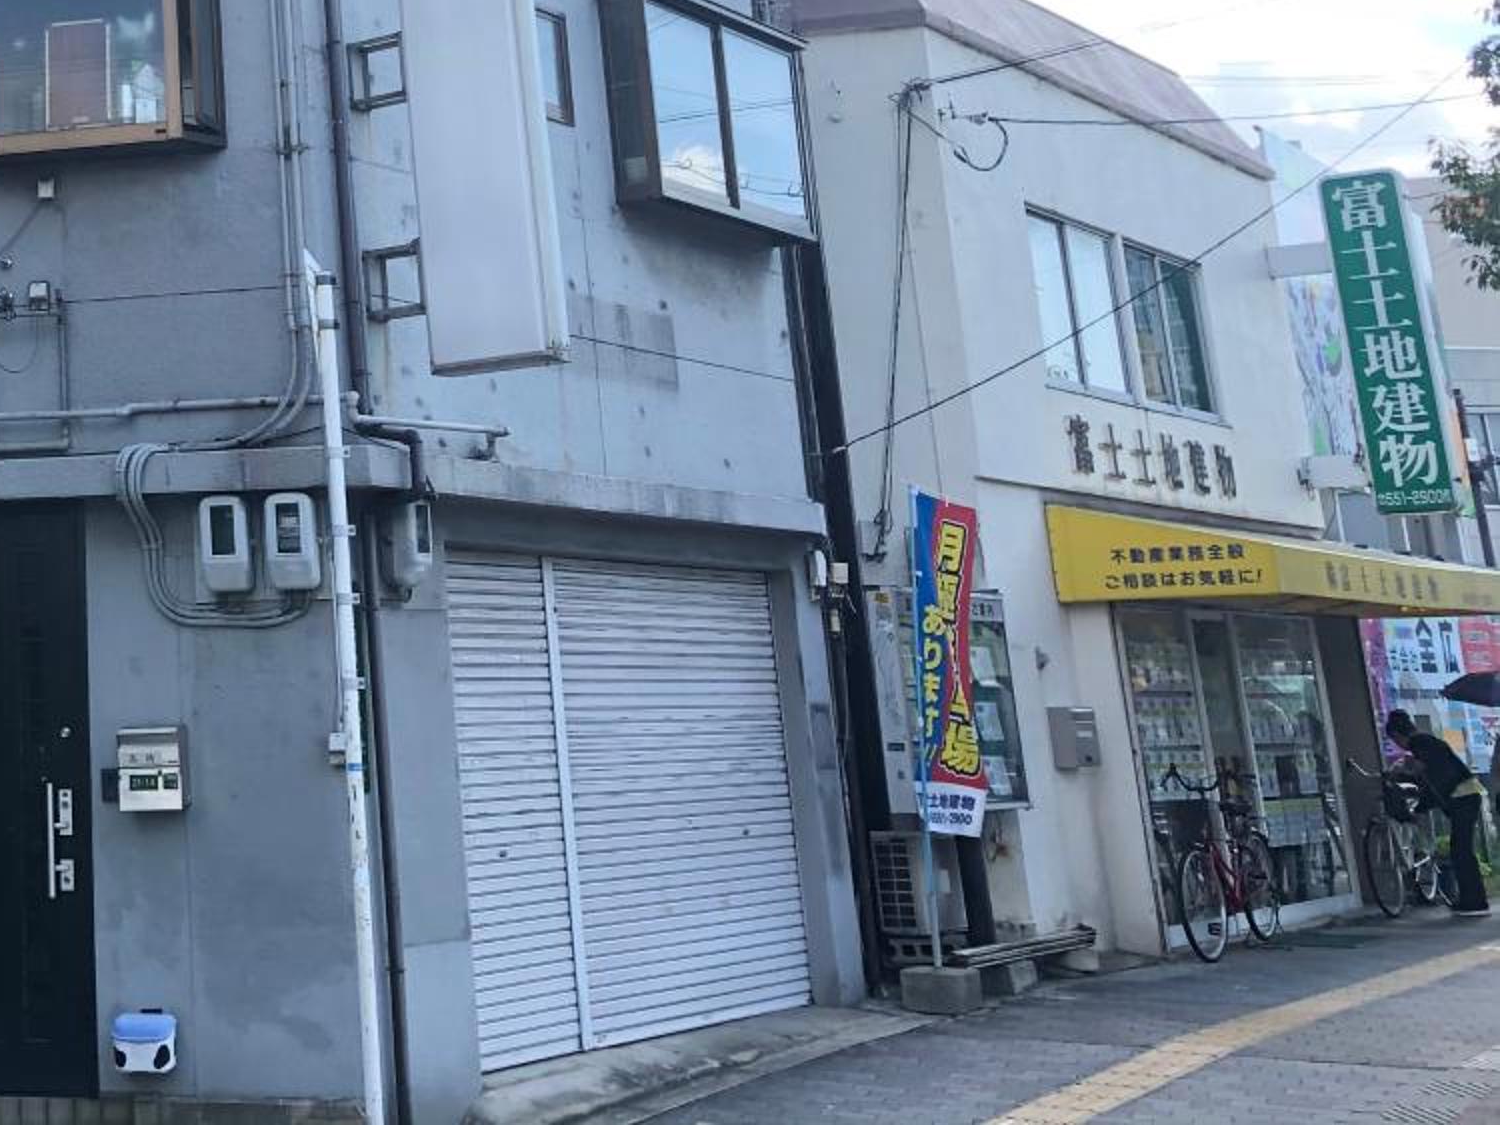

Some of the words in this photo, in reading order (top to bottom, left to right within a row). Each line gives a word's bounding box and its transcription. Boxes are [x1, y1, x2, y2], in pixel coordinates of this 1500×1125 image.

[1331, 181, 1440, 487] 富士土地建物
[1065, 414, 1237, 500] 富士土地建物
[1110, 543, 1246, 565] 不動産業務全般
[937, 521, 981, 776] 月極場
